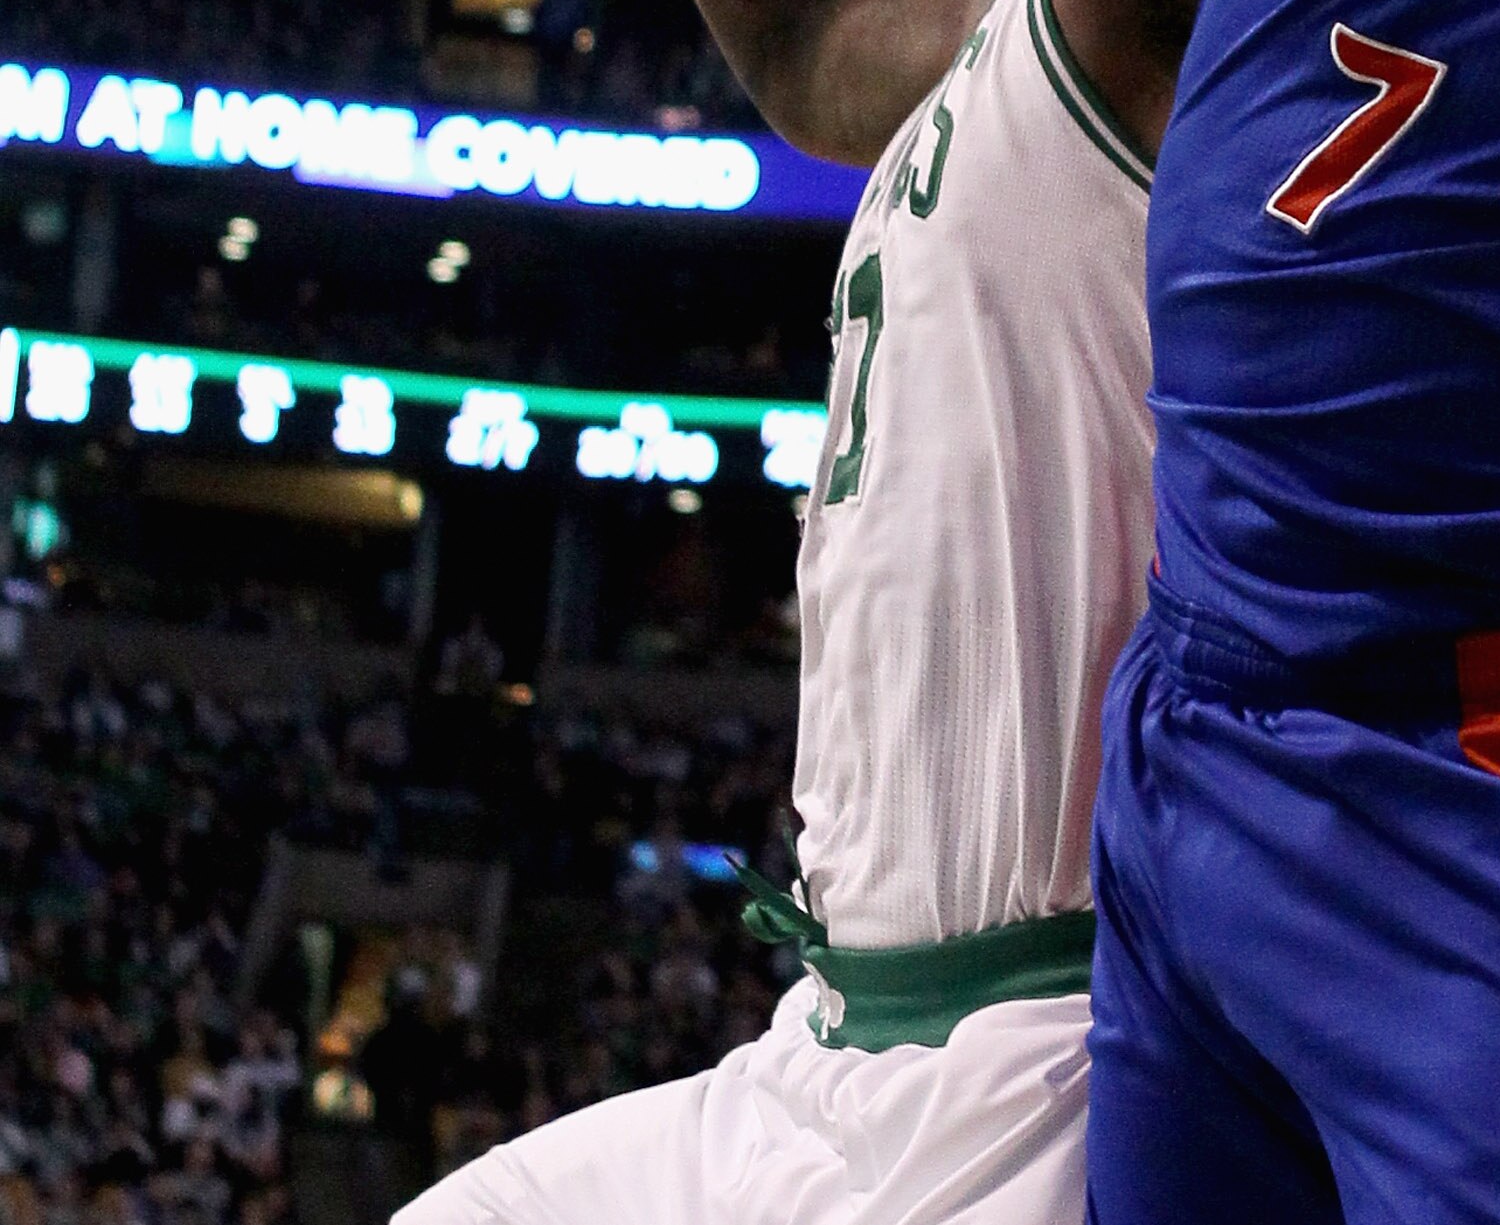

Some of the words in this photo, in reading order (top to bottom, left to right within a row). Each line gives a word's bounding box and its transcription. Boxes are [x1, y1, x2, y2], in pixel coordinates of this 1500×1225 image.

[77, 74, 182, 154] AT
[425, 115, 760, 210] COVERED
[1266, 22, 1448, 234] 7
